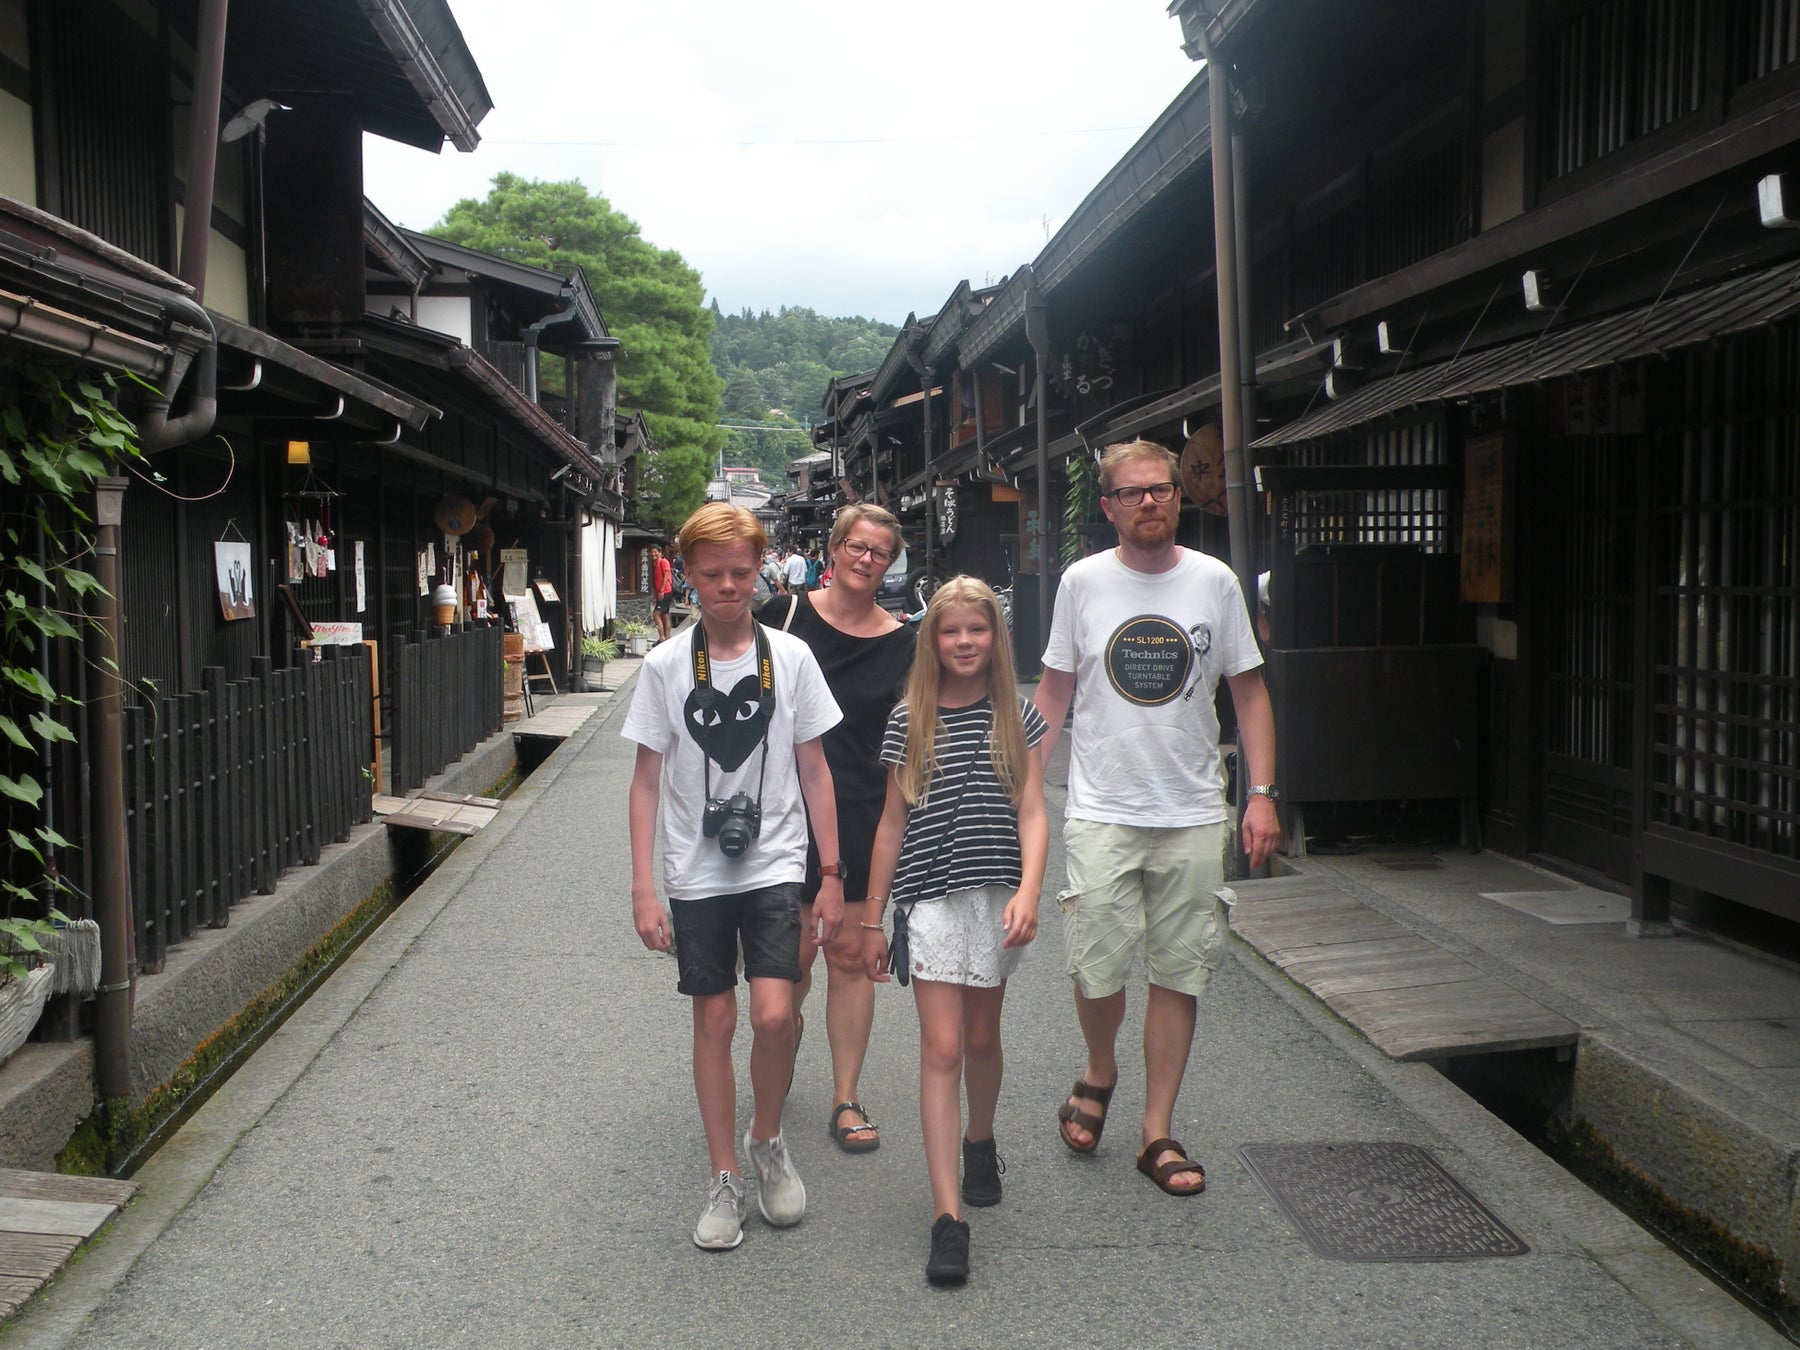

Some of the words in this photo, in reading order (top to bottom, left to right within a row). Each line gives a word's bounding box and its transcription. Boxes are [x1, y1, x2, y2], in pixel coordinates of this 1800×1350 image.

[944, 487, 957, 534] そばうどん
[1136, 636, 1165, 644] SL1200
[1122, 649, 1178, 660] Technics
[697, 651, 707, 681] Nikon
[1124, 663, 1150, 671] DIRECT
[1152, 664, 1175, 672] DRIVE
[762, 658, 771, 689] Nikon
[1128, 672, 1171, 681] TURNTABLE
[1134, 681, 1163, 689] SYSTEM
